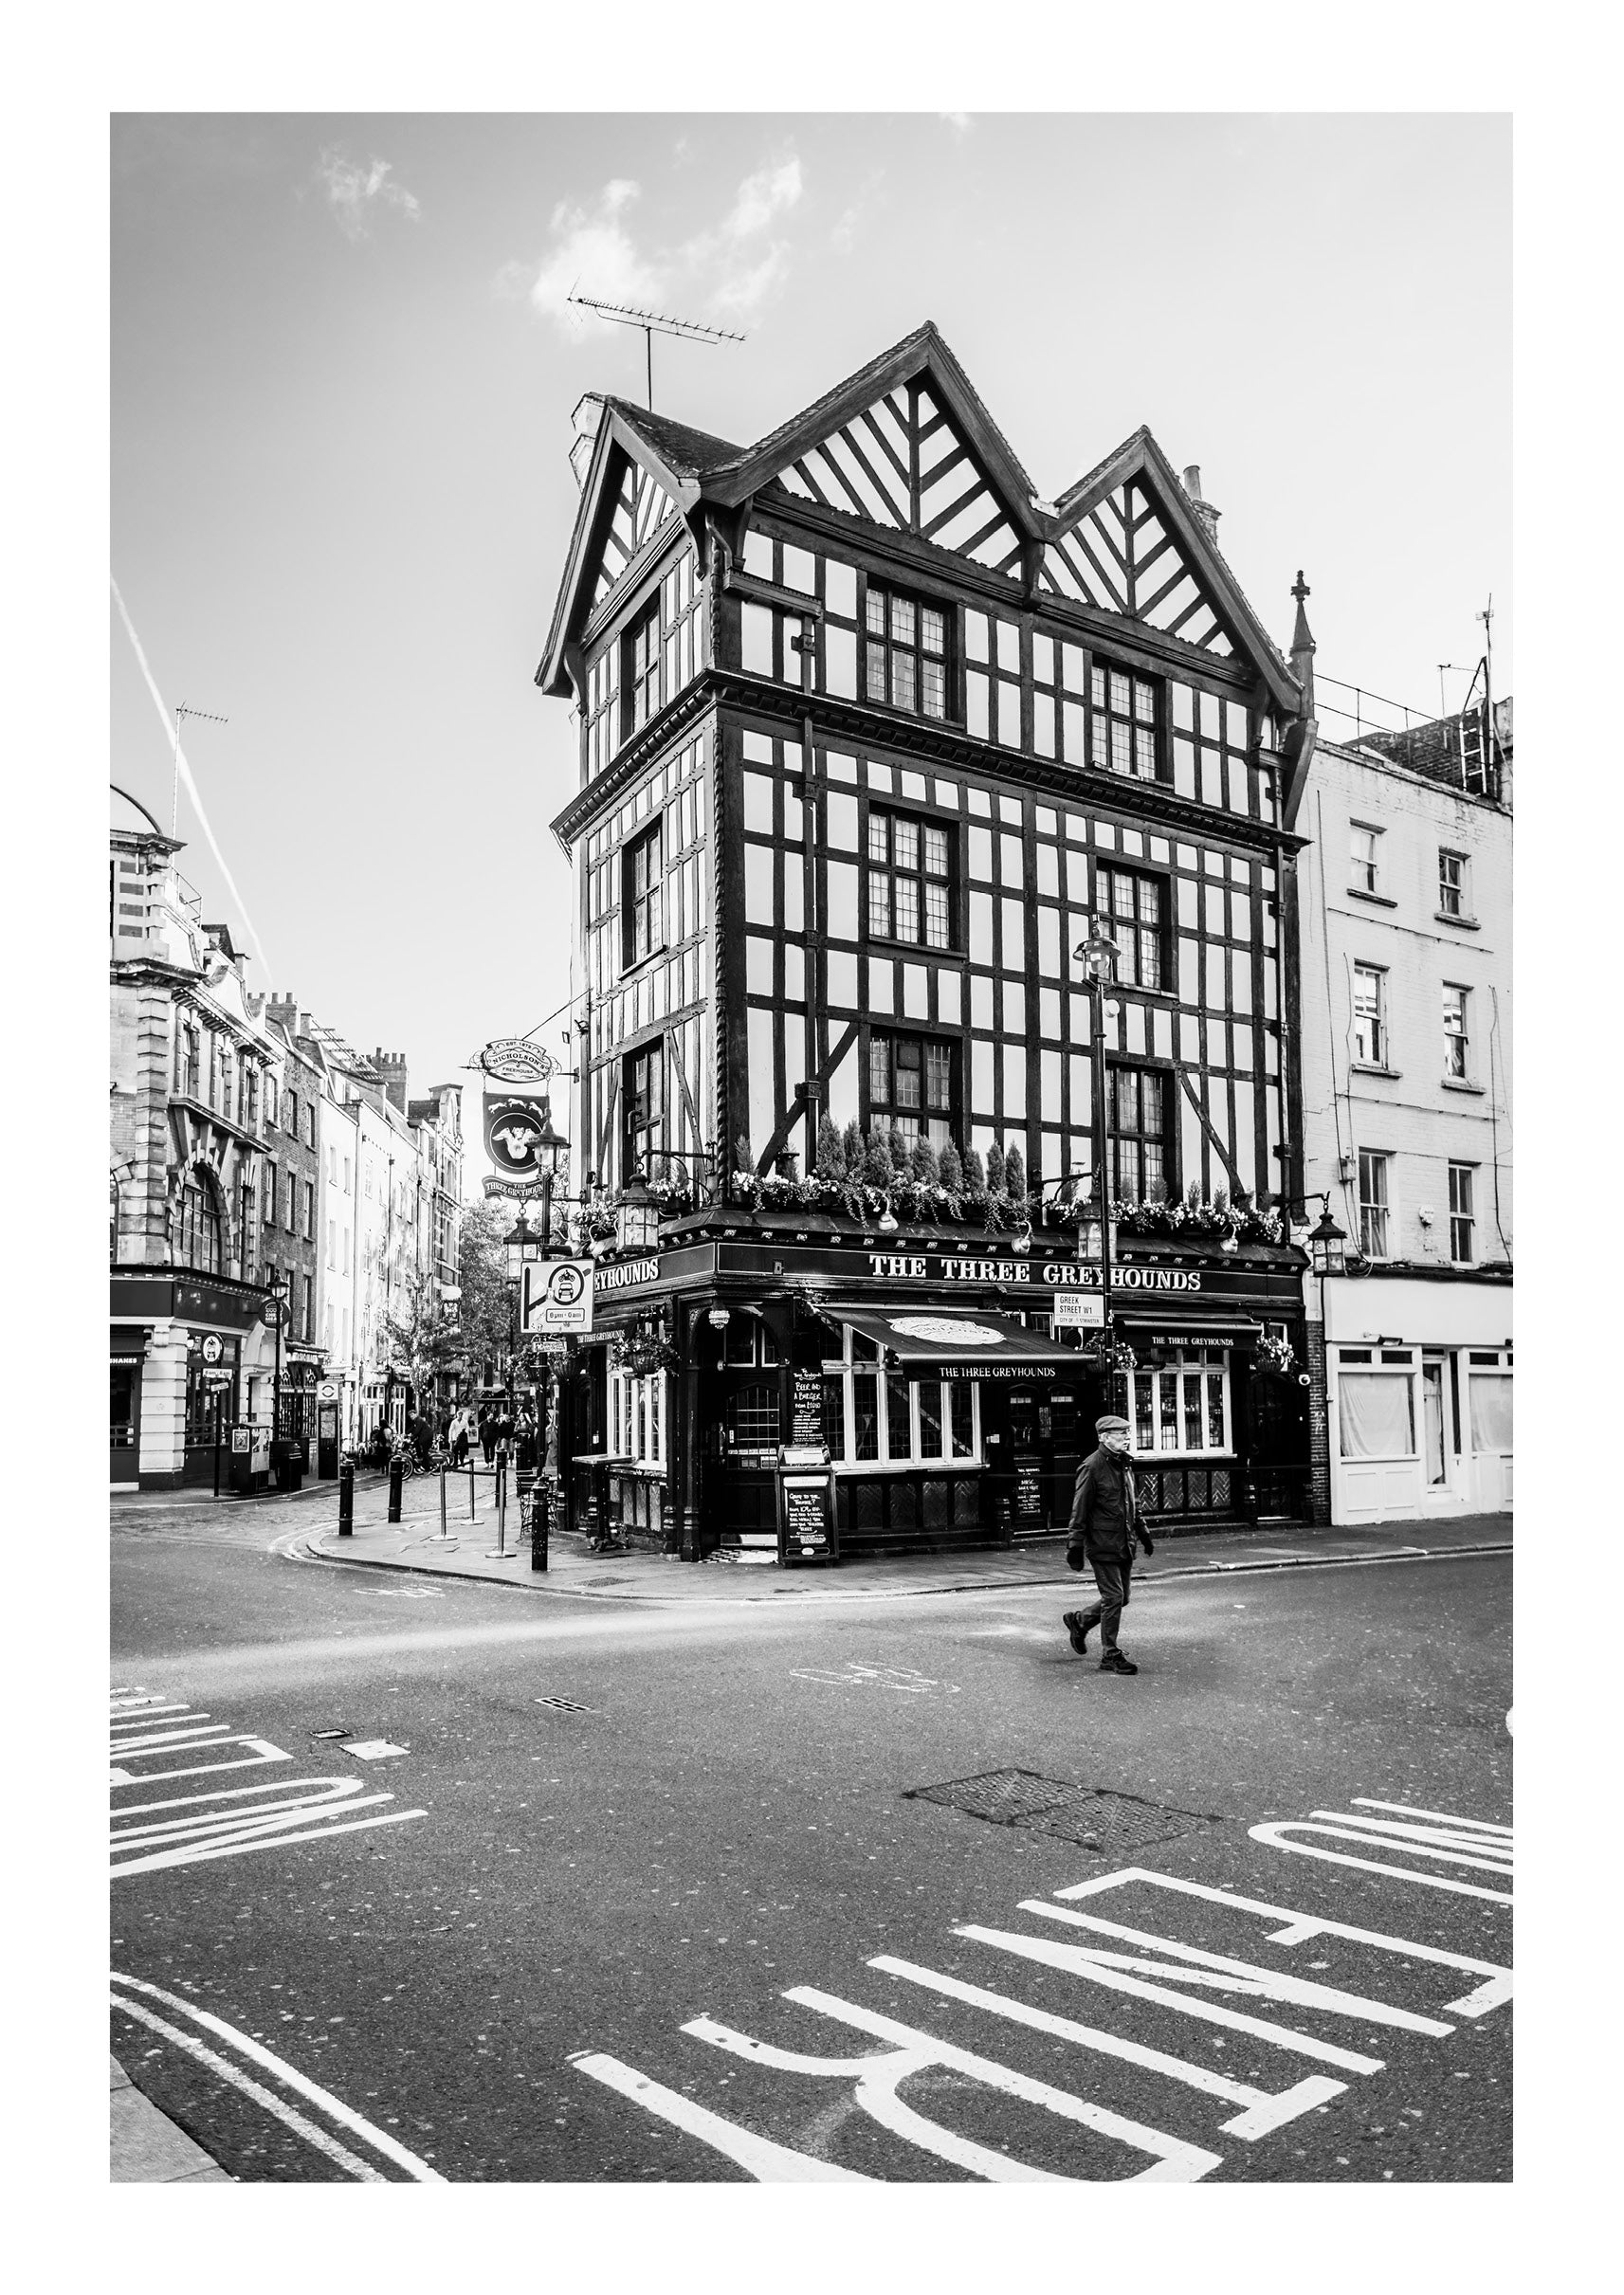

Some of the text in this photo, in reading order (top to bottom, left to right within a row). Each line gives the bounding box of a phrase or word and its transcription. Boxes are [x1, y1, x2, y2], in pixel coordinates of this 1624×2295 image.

[493, 1052, 545, 1069] NICHOLSON'S
[507, 1184, 543, 1197] GREYHOUN
[868, 1254, 1201, 1291] THE THREE GREYHOUNDS
[1059, 1296, 1079, 1304] GREEK
[1059, 1305, 1092, 1315] STREET W1
[1151, 1336, 1233, 1346] THE THREE GREYHOUNDS
[939, 1366, 1055, 1377] THE THREE GREYHOUNDS
